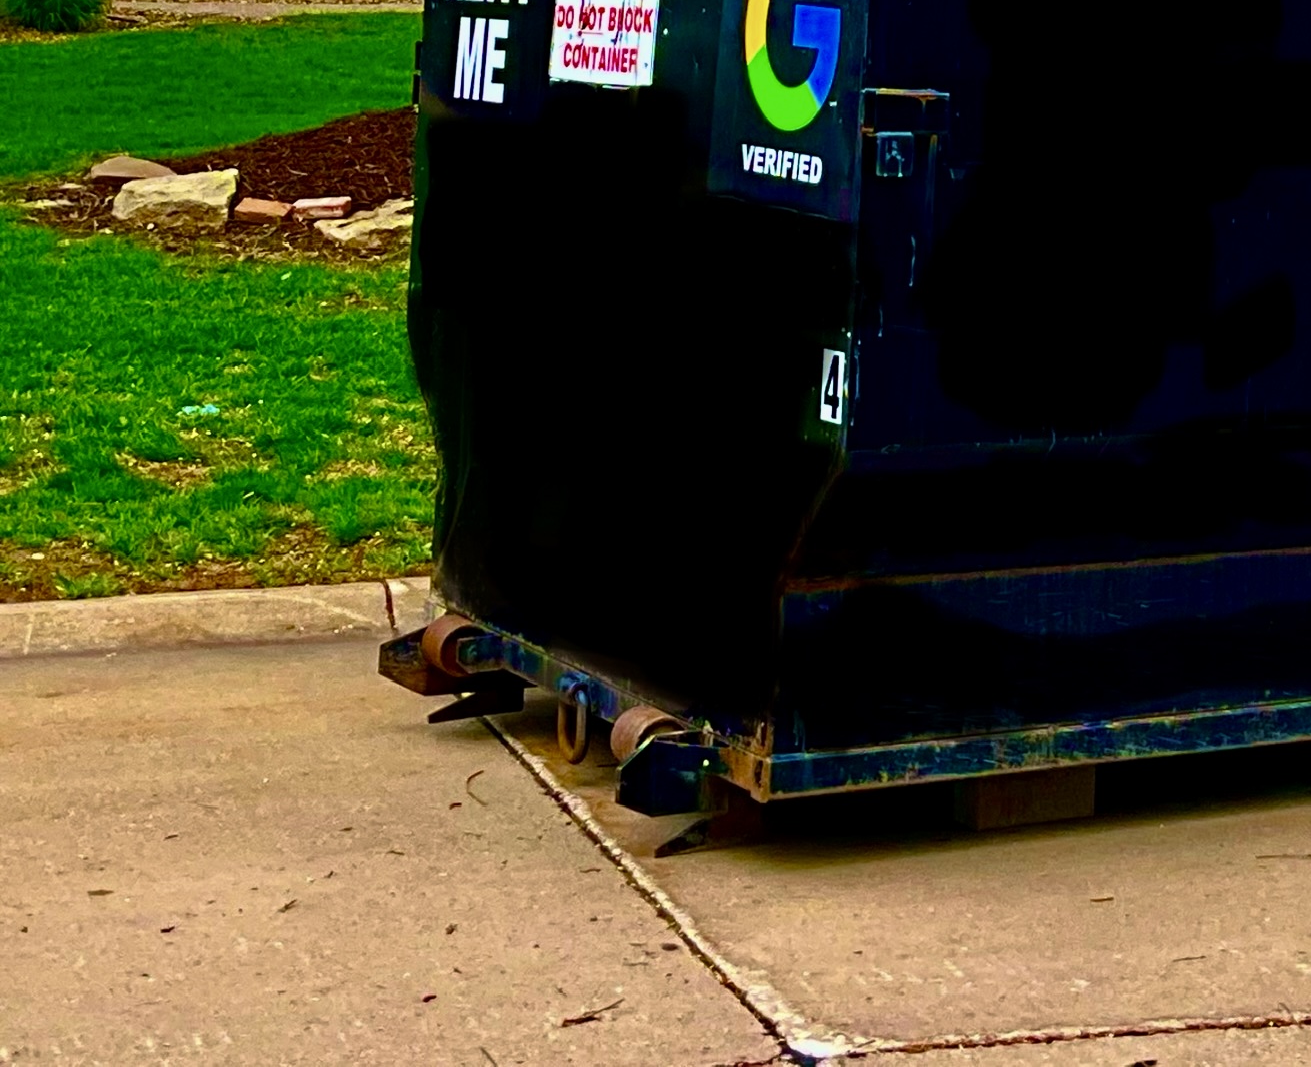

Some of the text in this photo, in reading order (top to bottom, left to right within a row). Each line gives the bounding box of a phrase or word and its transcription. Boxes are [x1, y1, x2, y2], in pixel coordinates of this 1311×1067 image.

[556, 5, 575, 29] DO
[607, 6, 654, 33] BLOCK
[453, 16, 510, 104] ME
[741, 143, 823, 185] VERIFIED
[823, 354, 840, 420] 4
